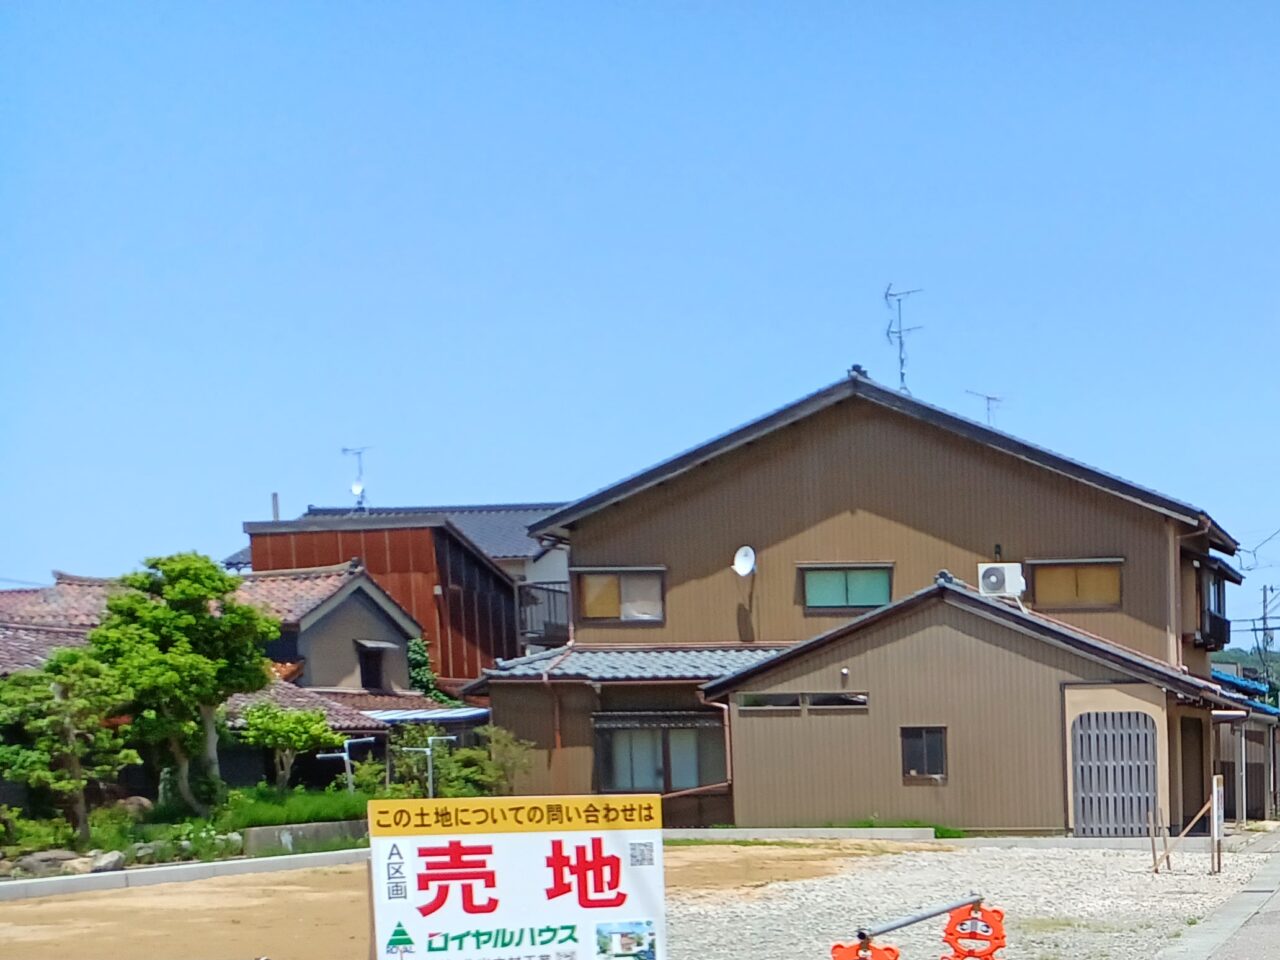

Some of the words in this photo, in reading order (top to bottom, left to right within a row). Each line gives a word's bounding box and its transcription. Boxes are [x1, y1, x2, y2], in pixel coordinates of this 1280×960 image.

[375, 802, 655, 829] この土地についての問い合わせは
[387, 843, 408, 900] A区画
[427, 924, 579, 952] ロイヤルハウス
